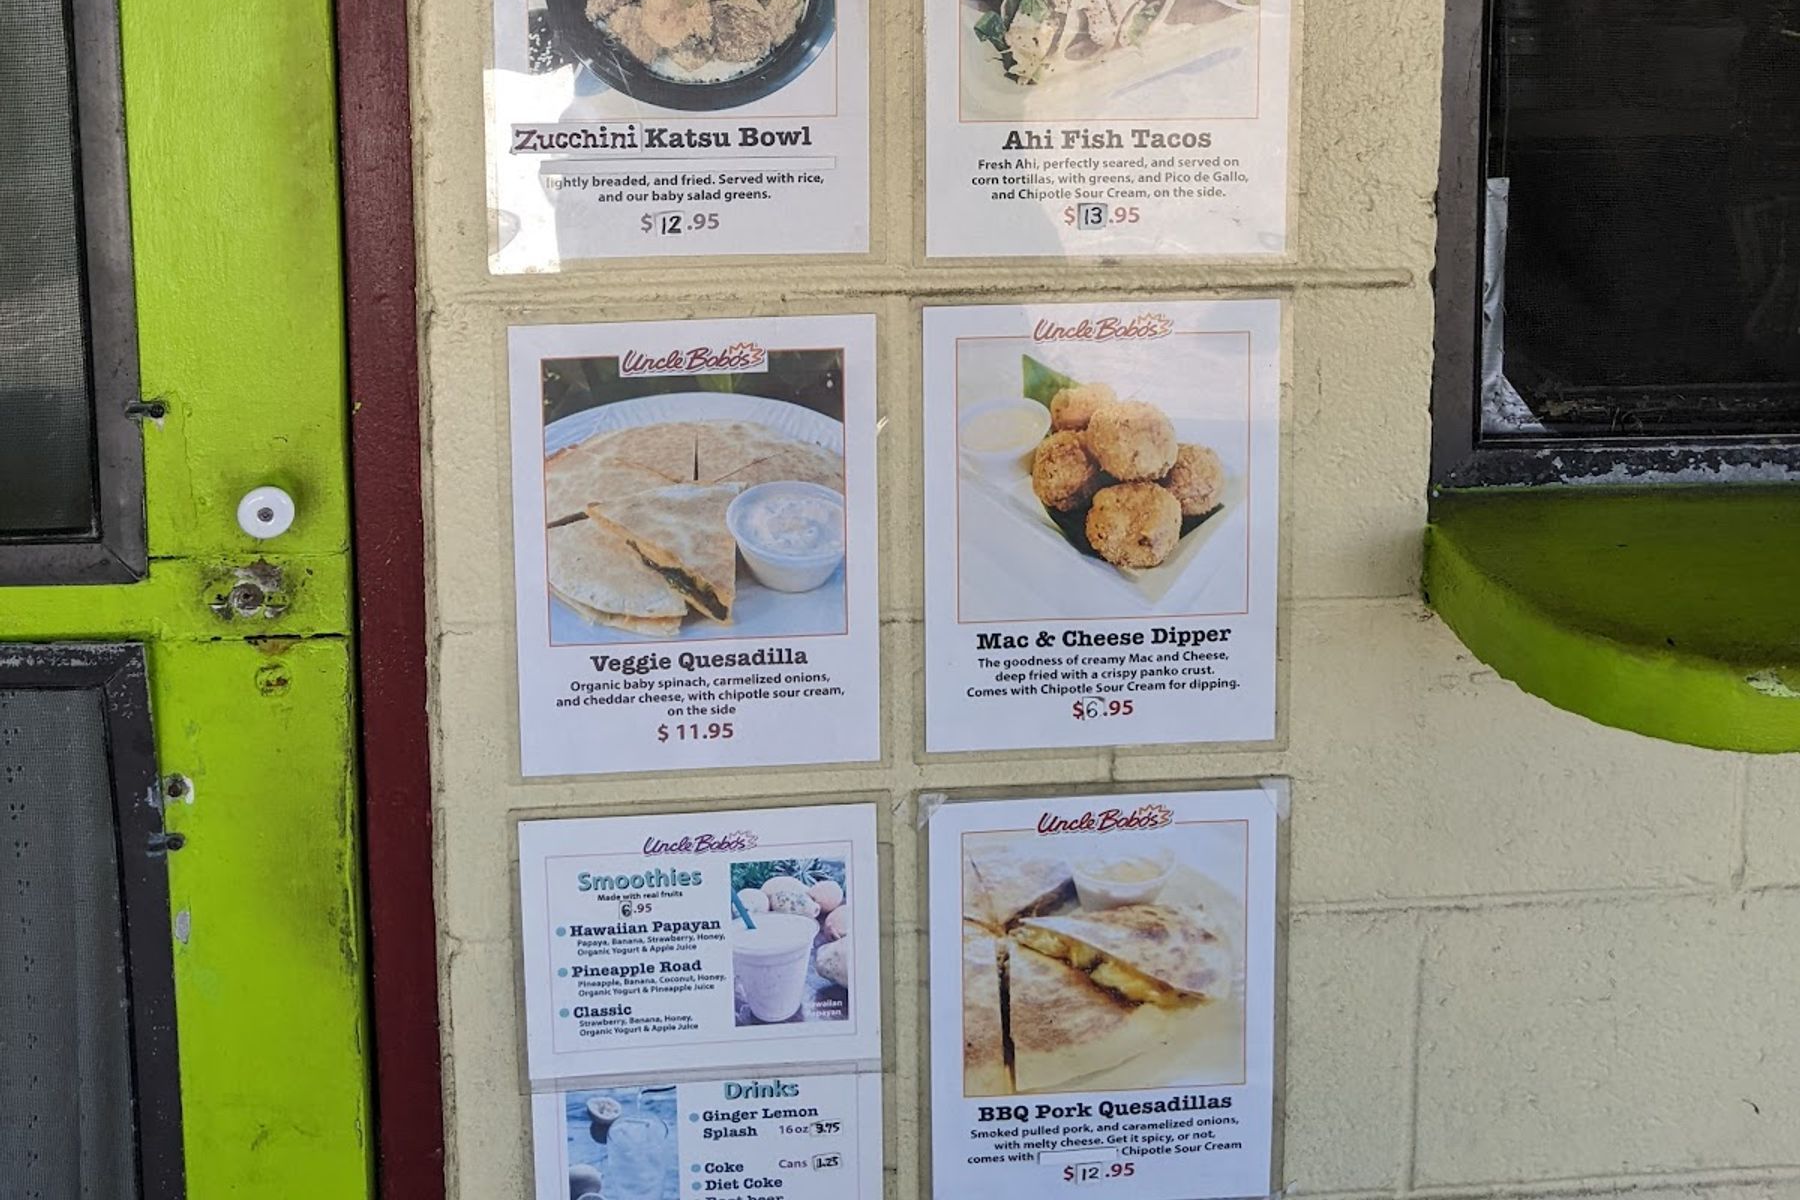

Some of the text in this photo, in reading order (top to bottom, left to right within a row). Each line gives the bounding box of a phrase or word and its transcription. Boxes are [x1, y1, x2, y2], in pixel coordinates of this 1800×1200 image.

[514, 124, 812, 150] Zucchini Katsu Bowl
[1002, 129, 1212, 150] Ahi Fish Tacos
[592, 175, 650, 188] breaded,
[654, 175, 677, 186] and
[681, 174, 715, 186] fried.
[719, 174, 763, 185] Served
[766, 173, 795, 184] with
[798, 173, 824, 184] rice,
[972, 172, 1248, 186] corn tortillas, with greens, and Pico de Gallo,
[598, 190, 771, 203] and our baby salad greens.
[1034, 318, 1094, 342] Uncle
[622, 350, 684, 372] Uncle
[977, 627, 1231, 650] Mac & Cheese Dipper
[590, 648, 808, 674] Veggie Quesadilla
[570, 673, 830, 693] Organic baby spinach, carmelized onions,
[967, 678, 1240, 698] Comes with Chipotle Sour Cream for dipping.
[668, 704, 736, 716] on the side
[1038, 812, 1094, 833] Uncle
[643, 836, 693, 855] Uncle
[578, 868, 702, 892] Smoothies
[623, 892, 640, 900] with
[643, 891, 658, 899] real
[661, 890, 683, 898] fruits
[570, 919, 721, 937] Hawaiian Papayan
[572, 961, 701, 979] Pineapple Road
[574, 1005, 632, 1018] Classic
[725, 1080, 799, 1100] Drinks
[703, 1107, 818, 1123] Ginger Lemon
[979, 1095, 1232, 1122] BBQ Pork Quesadillas
[704, 1127, 758, 1140] Splash
[994, 1131, 1215, 1150] with melty cheese. Get it spicy, or not,
[705, 1163, 744, 1173] Coke
[779, 1160, 808, 1168] Cans
[706, 1178, 782, 1190] Diet Coke
